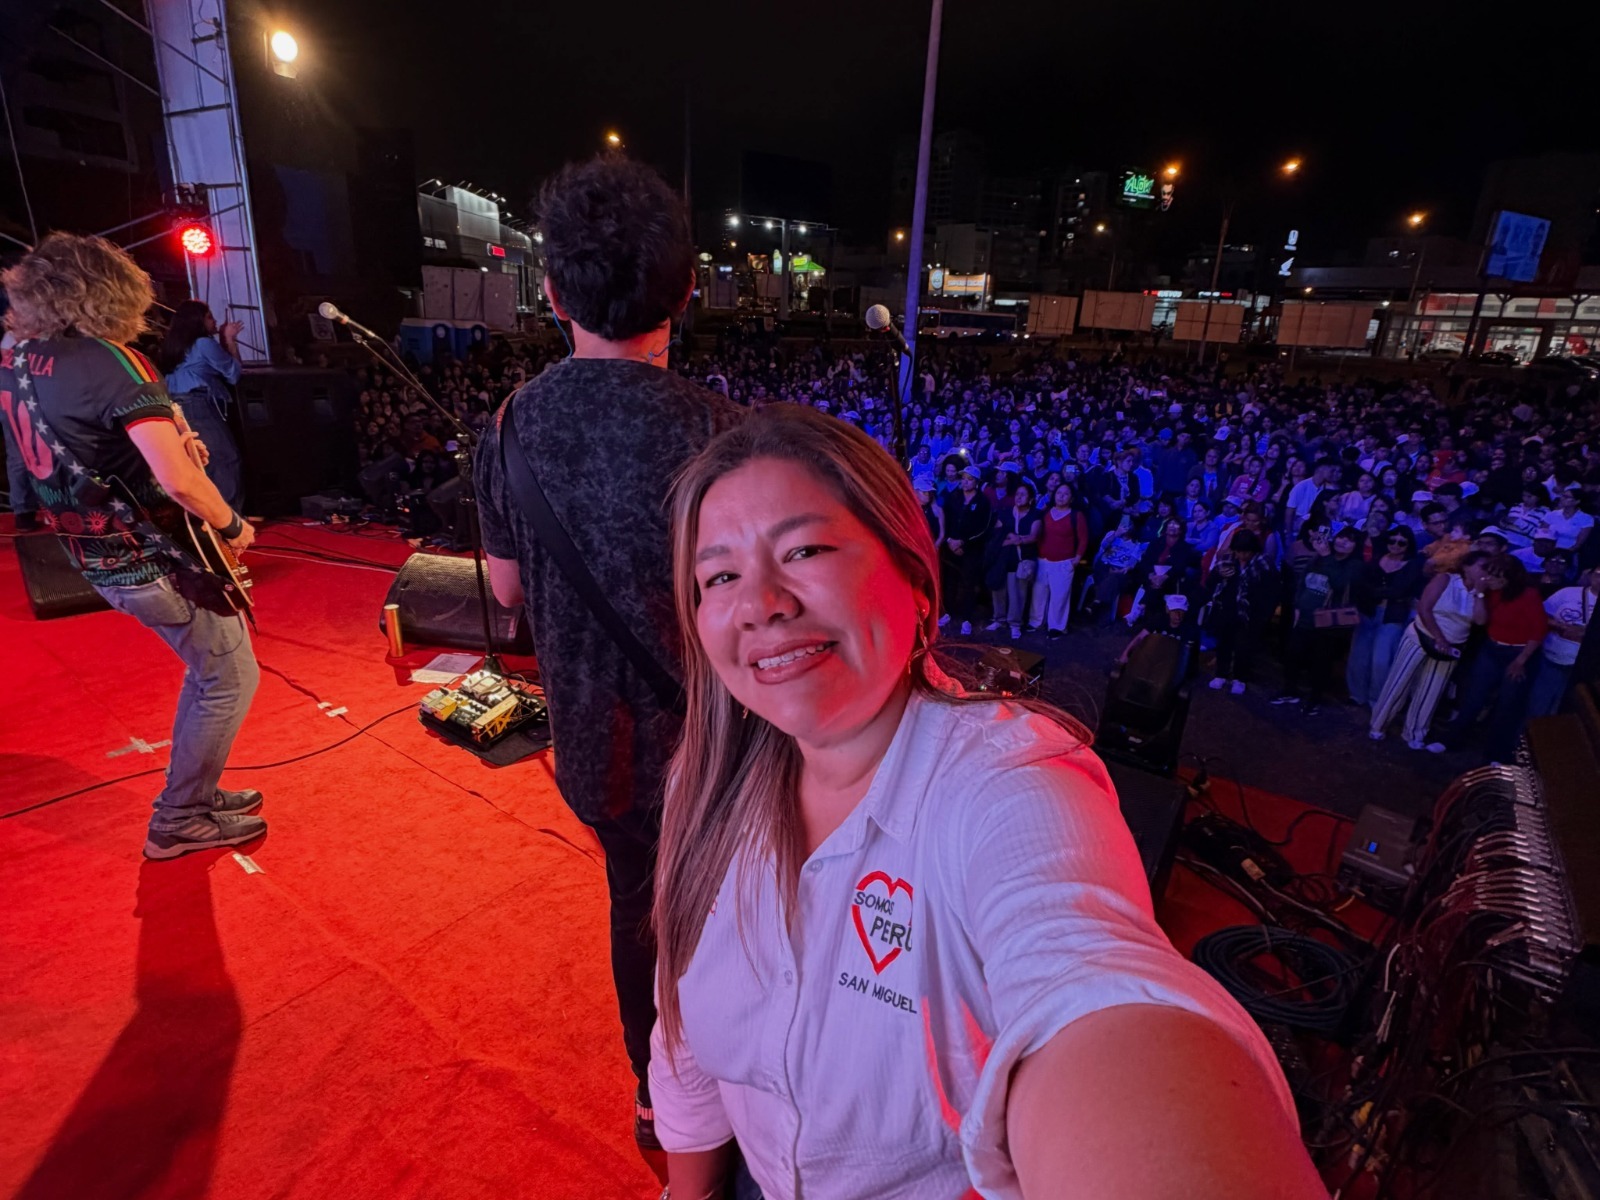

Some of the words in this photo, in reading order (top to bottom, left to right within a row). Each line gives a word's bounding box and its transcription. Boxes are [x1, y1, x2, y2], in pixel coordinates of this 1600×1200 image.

[853, 891, 895, 916] SOMOS
[838, 972, 869, 994] SAN
[871, 982, 918, 1014] MIGUEL
